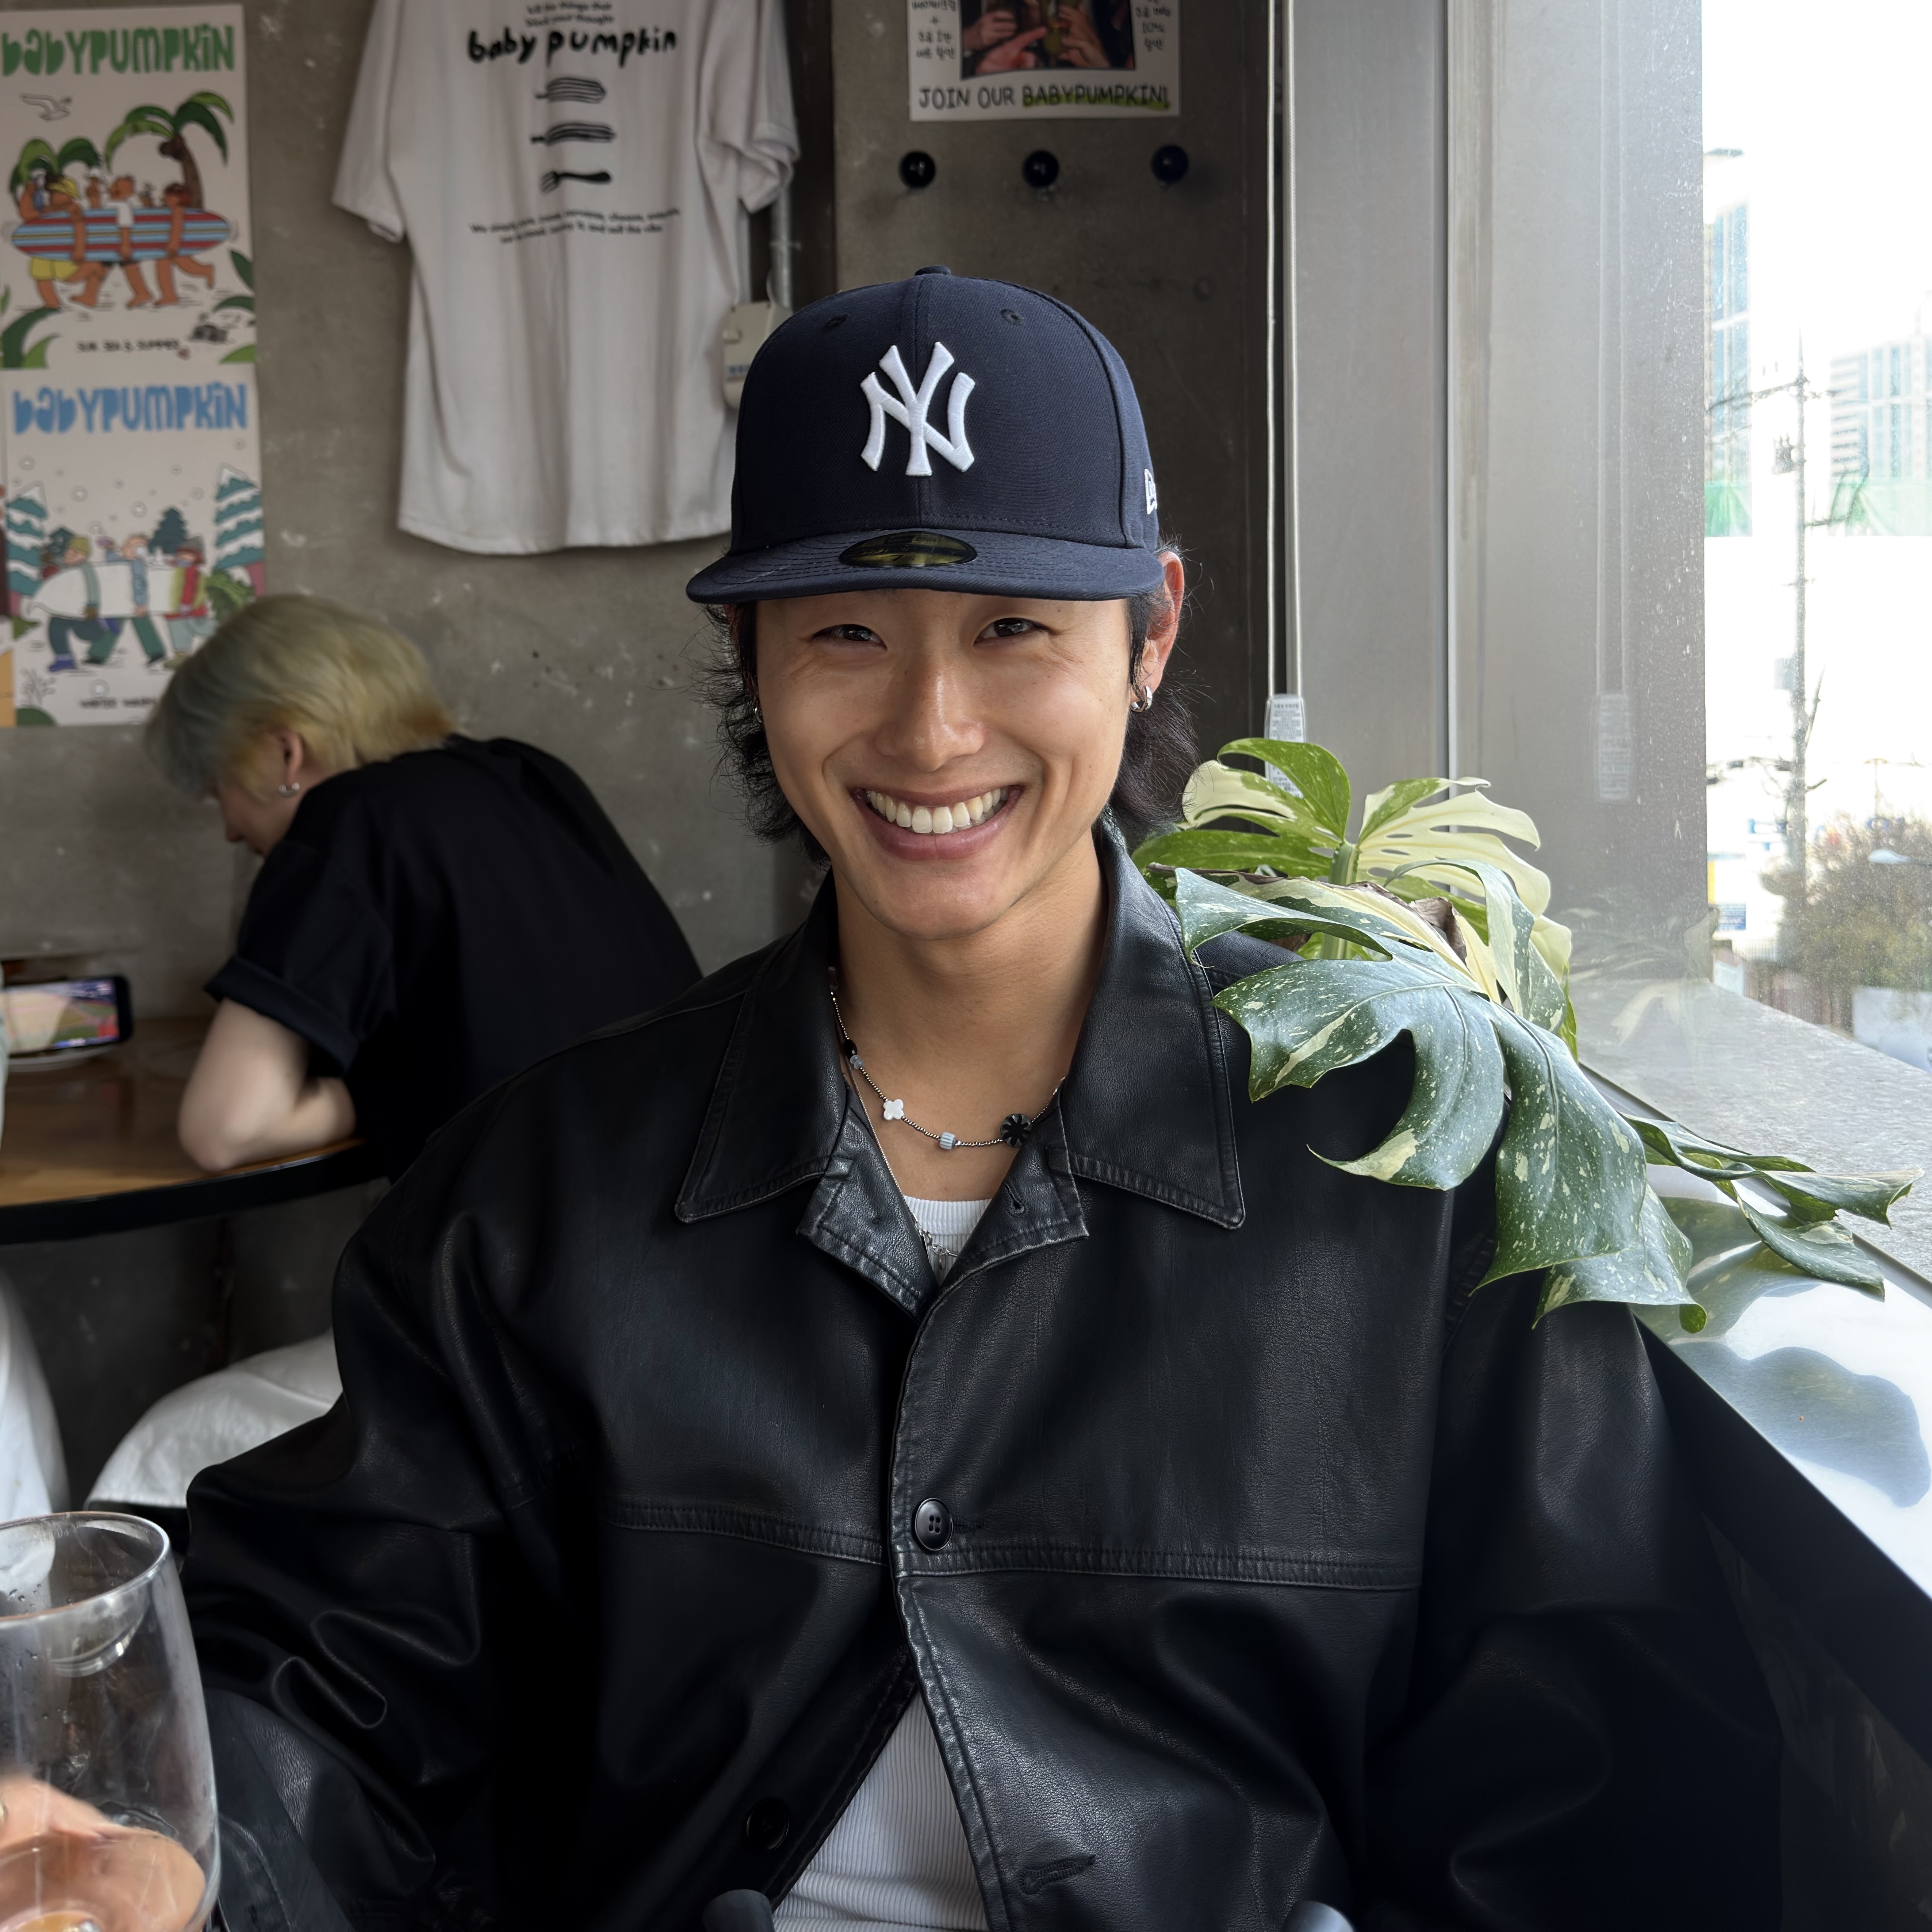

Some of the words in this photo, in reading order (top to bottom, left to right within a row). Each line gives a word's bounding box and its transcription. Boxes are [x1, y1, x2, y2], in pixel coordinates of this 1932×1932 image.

[467, 26, 537, 64] baby
[546, 27, 676, 68] pumpkin
[919, 87, 970, 110] JOIN
[978, 86, 1016, 109] OUR
[1023, 83, 1170, 109] BABYPUMPKIN!
[860, 342, 975, 476] NY
